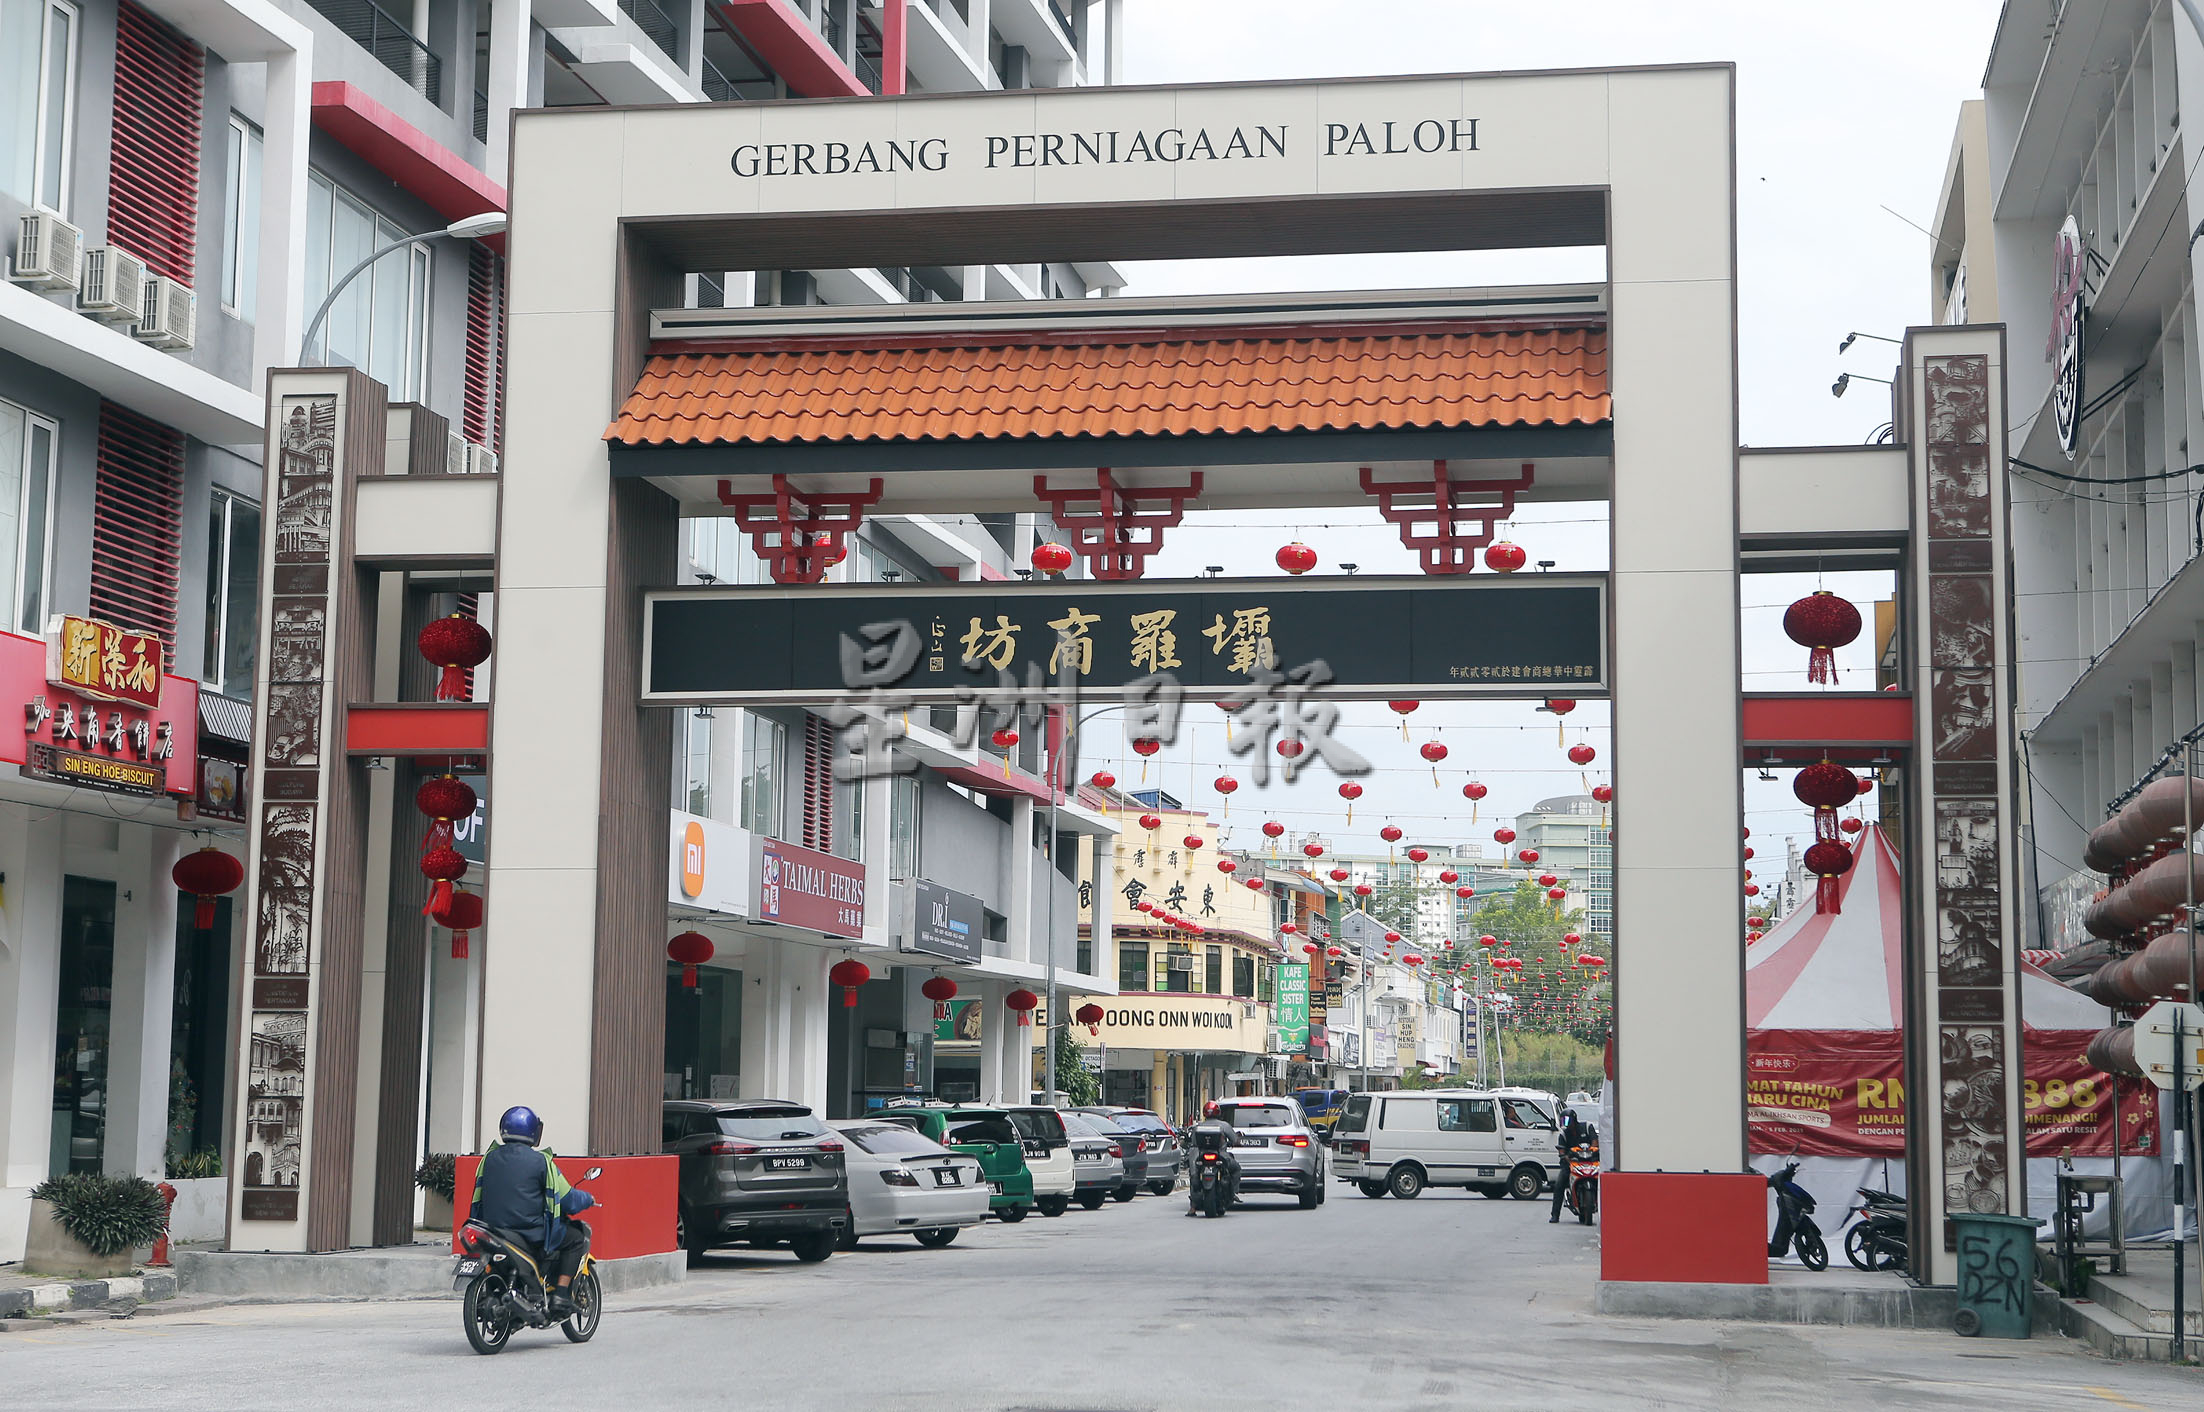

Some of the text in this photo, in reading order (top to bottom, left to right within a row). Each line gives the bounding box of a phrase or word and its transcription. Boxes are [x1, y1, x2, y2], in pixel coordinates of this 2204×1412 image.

[730, 118, 1481, 178] GERBANG PERNIAGAAN PALOH
[64, 757, 81, 773] SIN
[82, 760, 101, 777] ENG
[102, 765, 120, 779] HOE
[121, 767, 155, 786] BISCUIT
[829, 872, 864, 906] HERBS
[1283, 966, 1302, 978] KAFE
[1280, 980, 1306, 991] CLASSIC
[1282, 993, 1304, 1005] SISTER
[1097, 1009, 1154, 1027] OONG
[1159, 1010, 1189, 1027] ONN
[1192, 1011, 1212, 1028] WOI
[1281, 1007, 1306, 1023] 情人
[1755, 1058, 1792, 1069] 新年快乐
[1783, 1080, 1844, 1100] TAHUN
[1790, 1094, 1831, 1111] CINA
[1798, 1114, 1825, 1124] SPORTS
[2050, 1126, 2073, 1134] SATU
[2074, 1126, 2098, 1134] RESIT
[772, 1158, 786, 1168] BPV
[1962, 1235, 2019, 1281] 56
[1961, 1271, 2025, 1316] DZN
